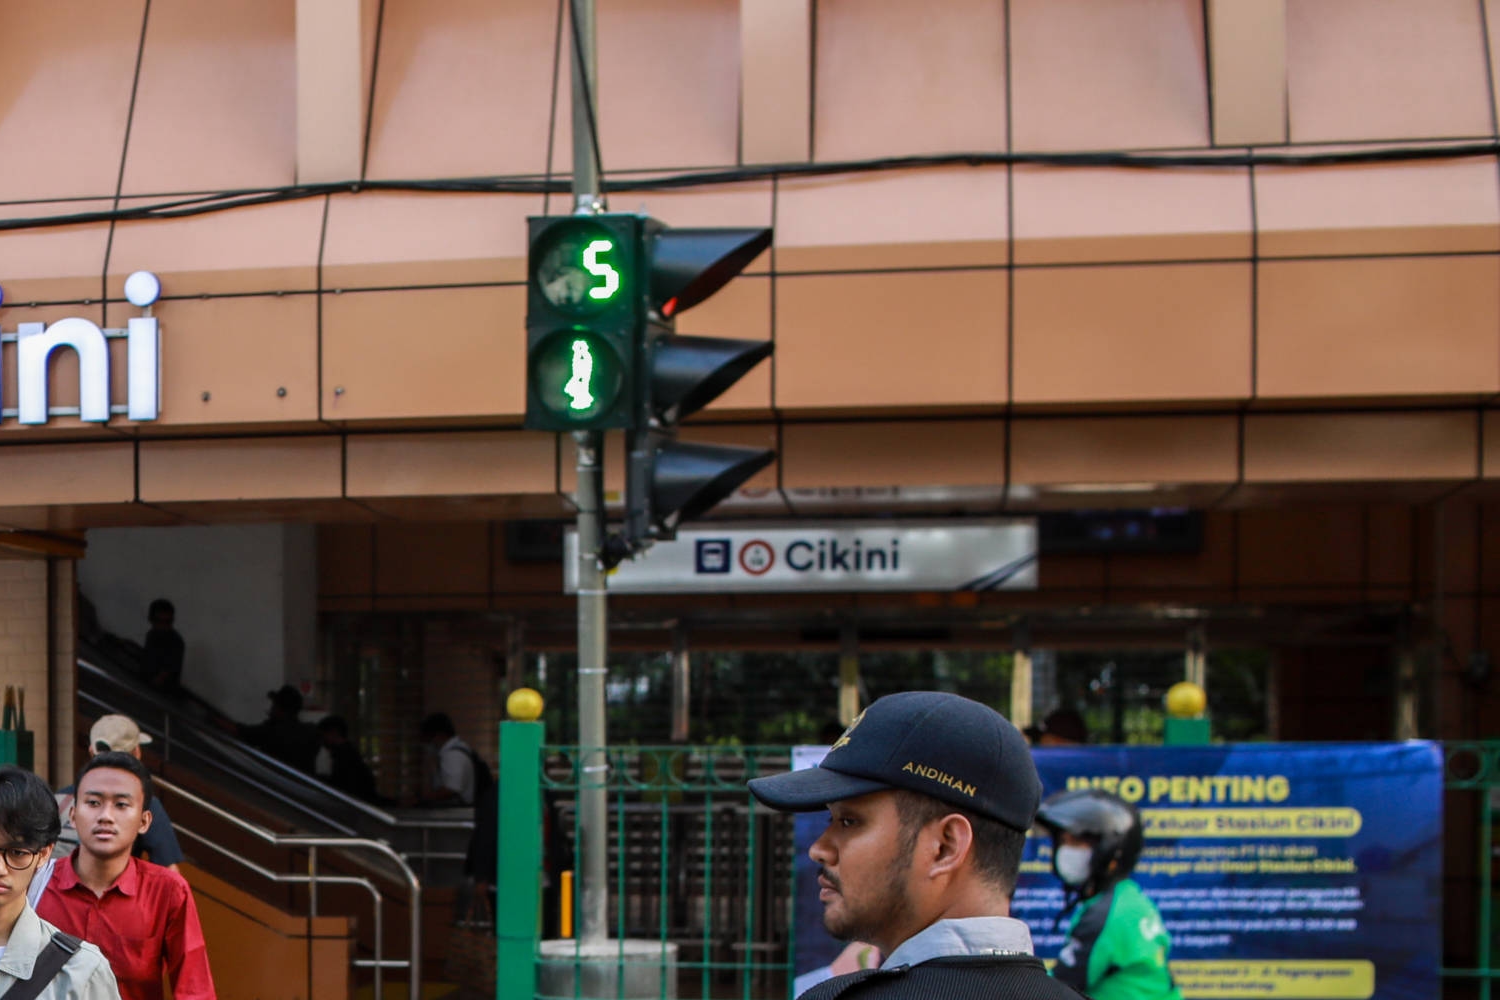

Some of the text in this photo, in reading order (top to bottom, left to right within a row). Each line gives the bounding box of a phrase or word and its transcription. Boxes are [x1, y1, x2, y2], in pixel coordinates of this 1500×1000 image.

[583, 240, 619, 299] 5
[784, 539, 899, 571] Cikini
[902, 761, 978, 798] ANDIHAN
[1149, 775, 1290, 802] PENTING
